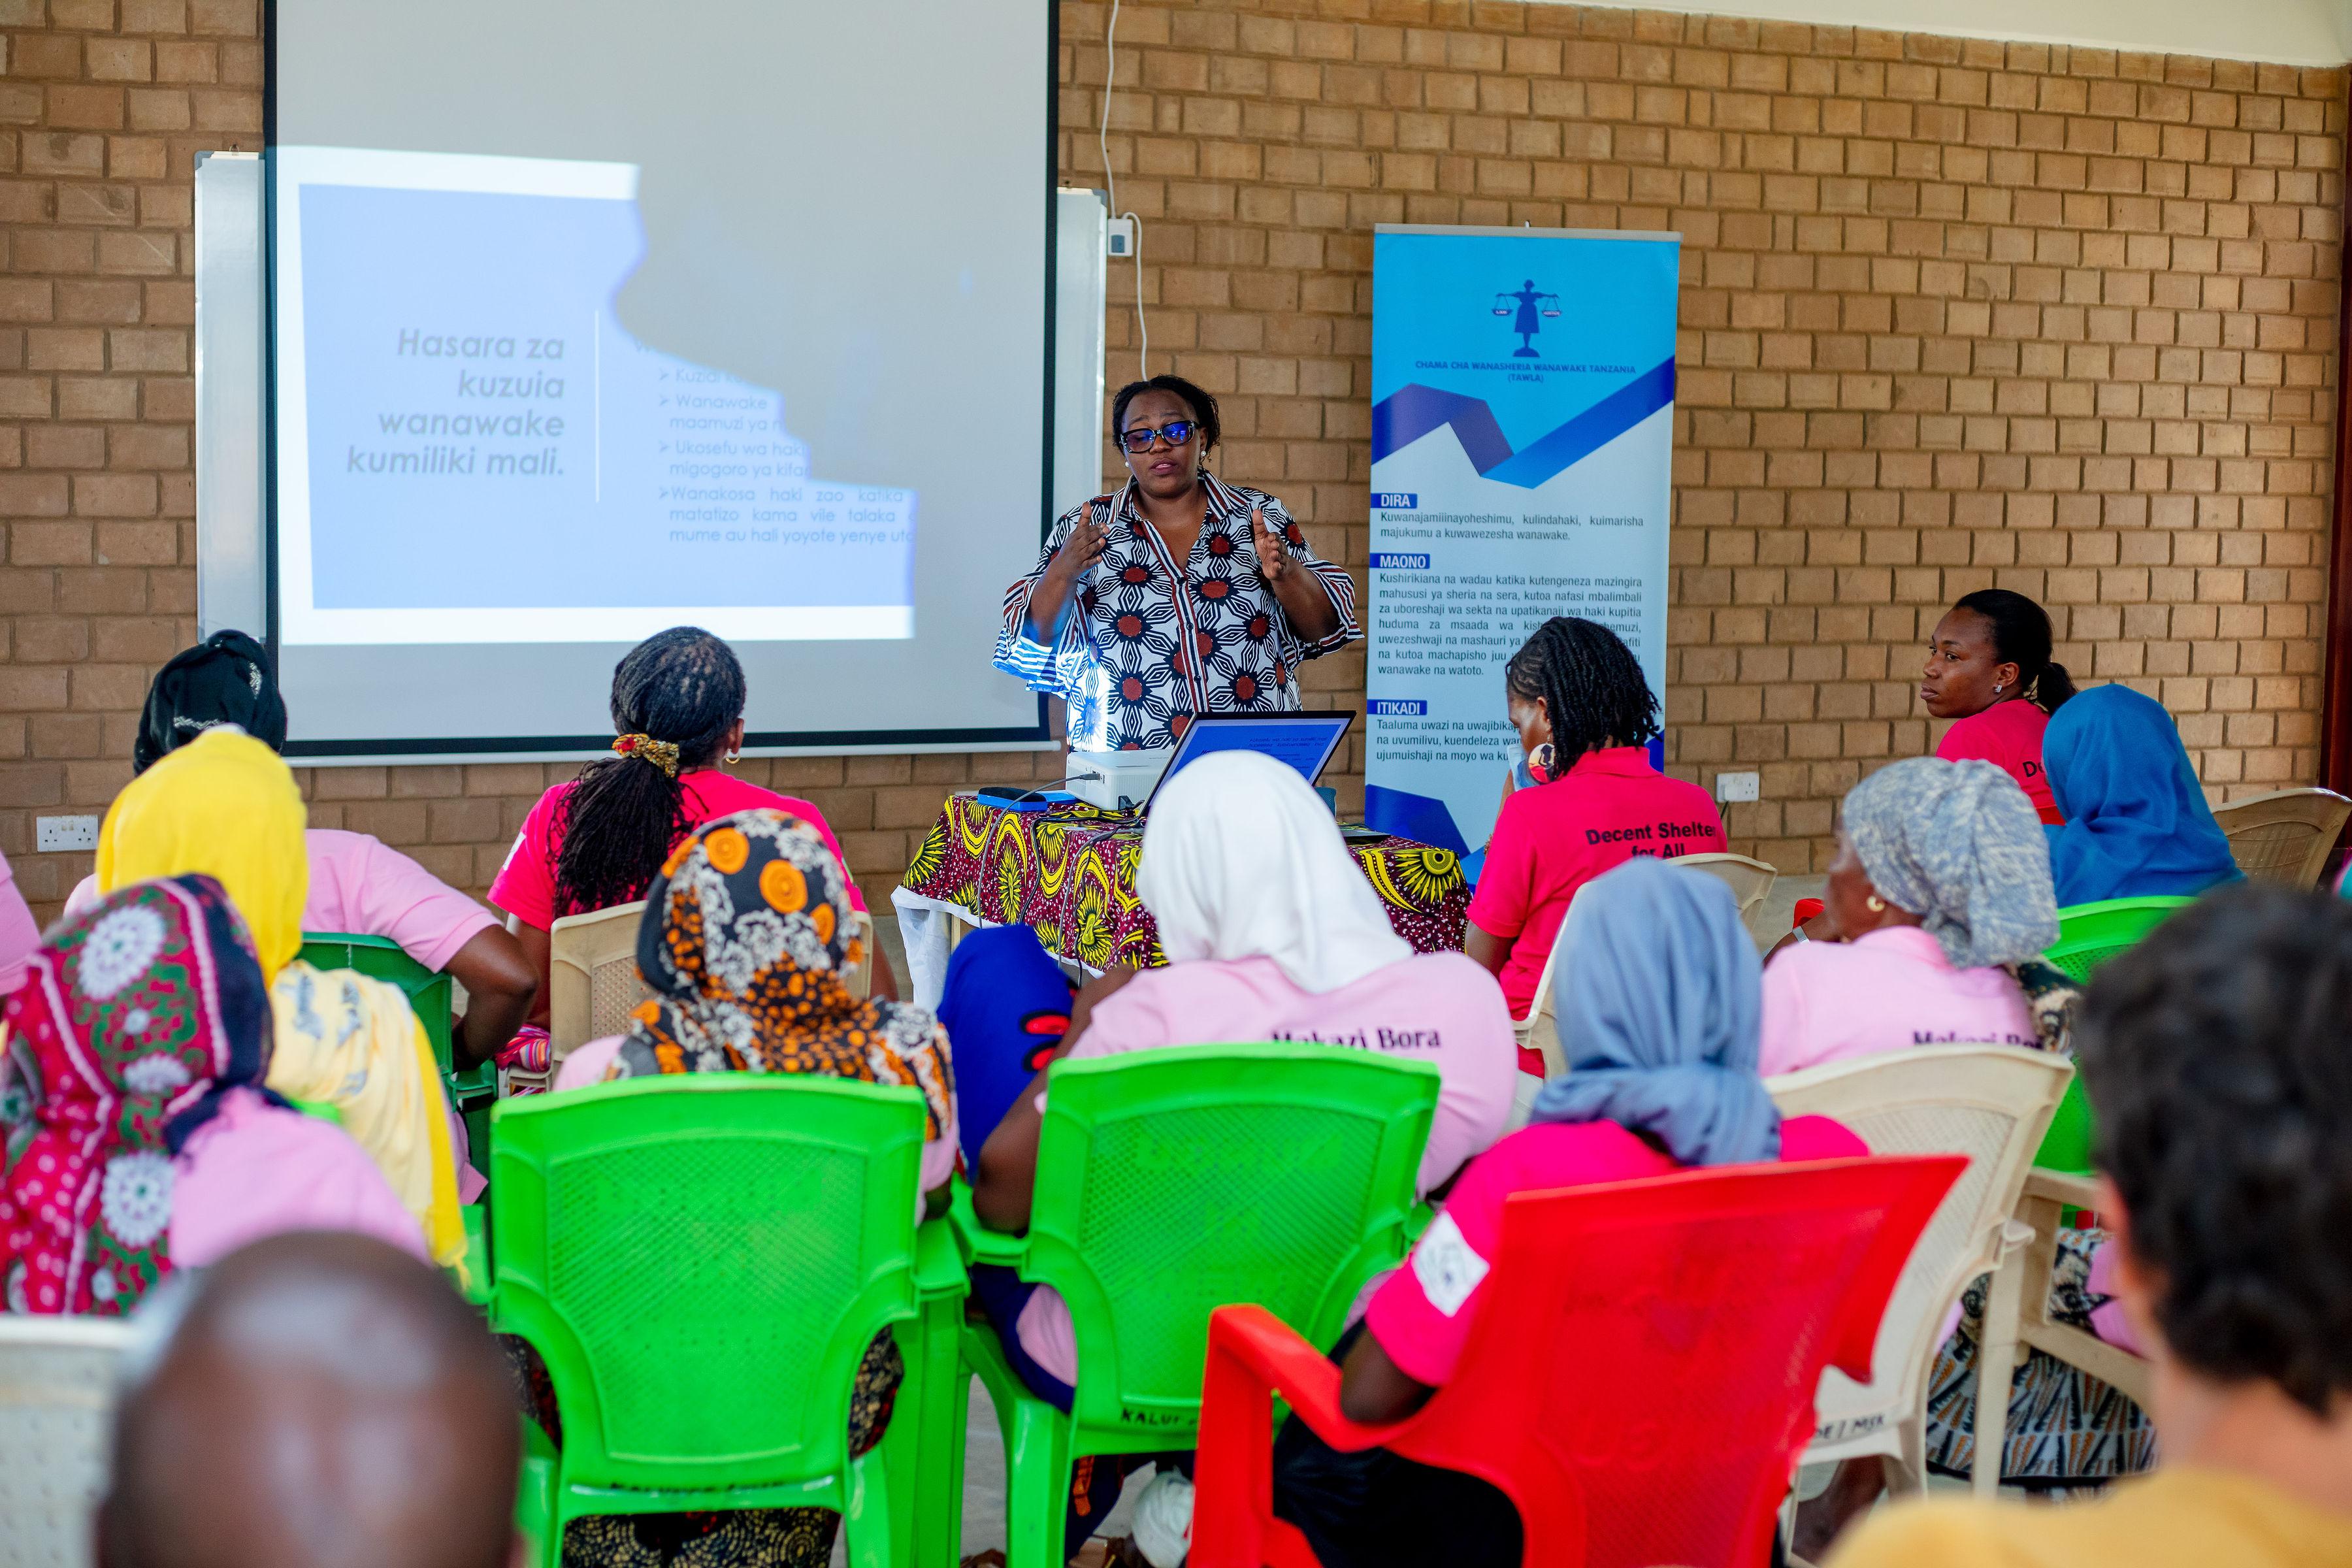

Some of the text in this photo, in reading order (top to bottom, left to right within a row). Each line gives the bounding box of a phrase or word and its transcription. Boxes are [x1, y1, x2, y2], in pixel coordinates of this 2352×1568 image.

[397, 328, 564, 359] Hasara za
[1415, 361, 1448, 369] CHAMA
[1472, 361, 1531, 371] WANASHERIA
[1535, 363, 1588, 373] WANAWAKE
[1590, 365, 1637, 374] TANZANIA
[458, 368, 564, 399] kuzuia
[1508, 373, 1544, 384] (TAWLA)
[676, 394, 768, 410] Wanawake
[378, 408, 565, 437] wanawake
[670, 416, 744, 431] maamuzi
[748, 419, 767, 433] ya
[676, 440, 737, 455] Ukosefu
[743, 444, 767, 455] wa
[347, 444, 564, 476] kumiliki mali.
[670, 461, 747, 478] migogoro
[753, 465, 772, 478] ya
[672, 487, 904, 503] Wanakosa haki zao katika
[1380, 494, 1411, 508] DIRA
[670, 508, 740, 522] matatizo
[753, 508, 797, 522] kama
[810, 508, 836, 522] vile
[849, 508, 896, 522] talaka
[1523, 514, 1581, 527] kulindahaki,
[1590, 515, 1644, 527] kuimarisha
[670, 529, 721, 542] mume
[725, 531, 746, 543] au
[751, 528, 778, 543] hali
[783, 528, 836, 546] yoyote
[840, 531, 886, 546] yenye
[1380, 527, 1433, 539] majukumu
[1445, 528, 1514, 539] kuwawezesha
[1516, 530, 1571, 540] wanawake.
[1380, 555, 1426, 568] MAONO
[1380, 573, 1441, 583] Kushirikiana
[1460, 575, 1492, 585] wadau
[1496, 576, 1526, 585] katika
[1529, 576, 1591, 587] kutengeneza
[1595, 576, 1642, 588] mazingira
[1380, 589, 1642, 602] mahususi ya sheria na sera, kutoa nafasi mbalimbali
[1394, 604, 1444, 615] uboreshaji
[1466, 605, 1492, 615] sekta
[1511, 606, 1563, 617] upatikanaji
[1568, 608, 1581, 616] wa
[1585, 606, 1605, 616] haki
[1609, 606, 1641, 618] kupitia
[1379, 619, 1419, 629] huduma
[1451, 620, 1488, 630] msaada
[1379, 634, 1442, 646] uwezeshwaji
[1461, 635, 1506, 645] mashauri
[1510, 637, 1520, 647] ya
[1379, 651, 1390, 659] na
[1396, 649, 1423, 659] kutoa
[1428, 650, 1486, 662] machapisho
[1492, 651, 1506, 662] juu
[1378, 664, 1484, 676] wanawake na watoto.
[1377, 702, 1420, 715] ITIKADI
[1377, 719, 1418, 730] Taaluma
[1422, 720, 1449, 730] uwazi
[1452, 722, 1464, 730] na
[1377, 736, 1388, 744] na
[1392, 735, 1441, 746] uvumilivu,
[1445, 736, 1499, 745] kuendeleza
[1377, 750, 1432, 762] ujumuishaji
[1451, 753, 1477, 762] moyo
[1585, 824, 1652, 845] Decent
[1662, 843, 1686, 860] All
[1377, 1026, 1441, 1049] Bora
